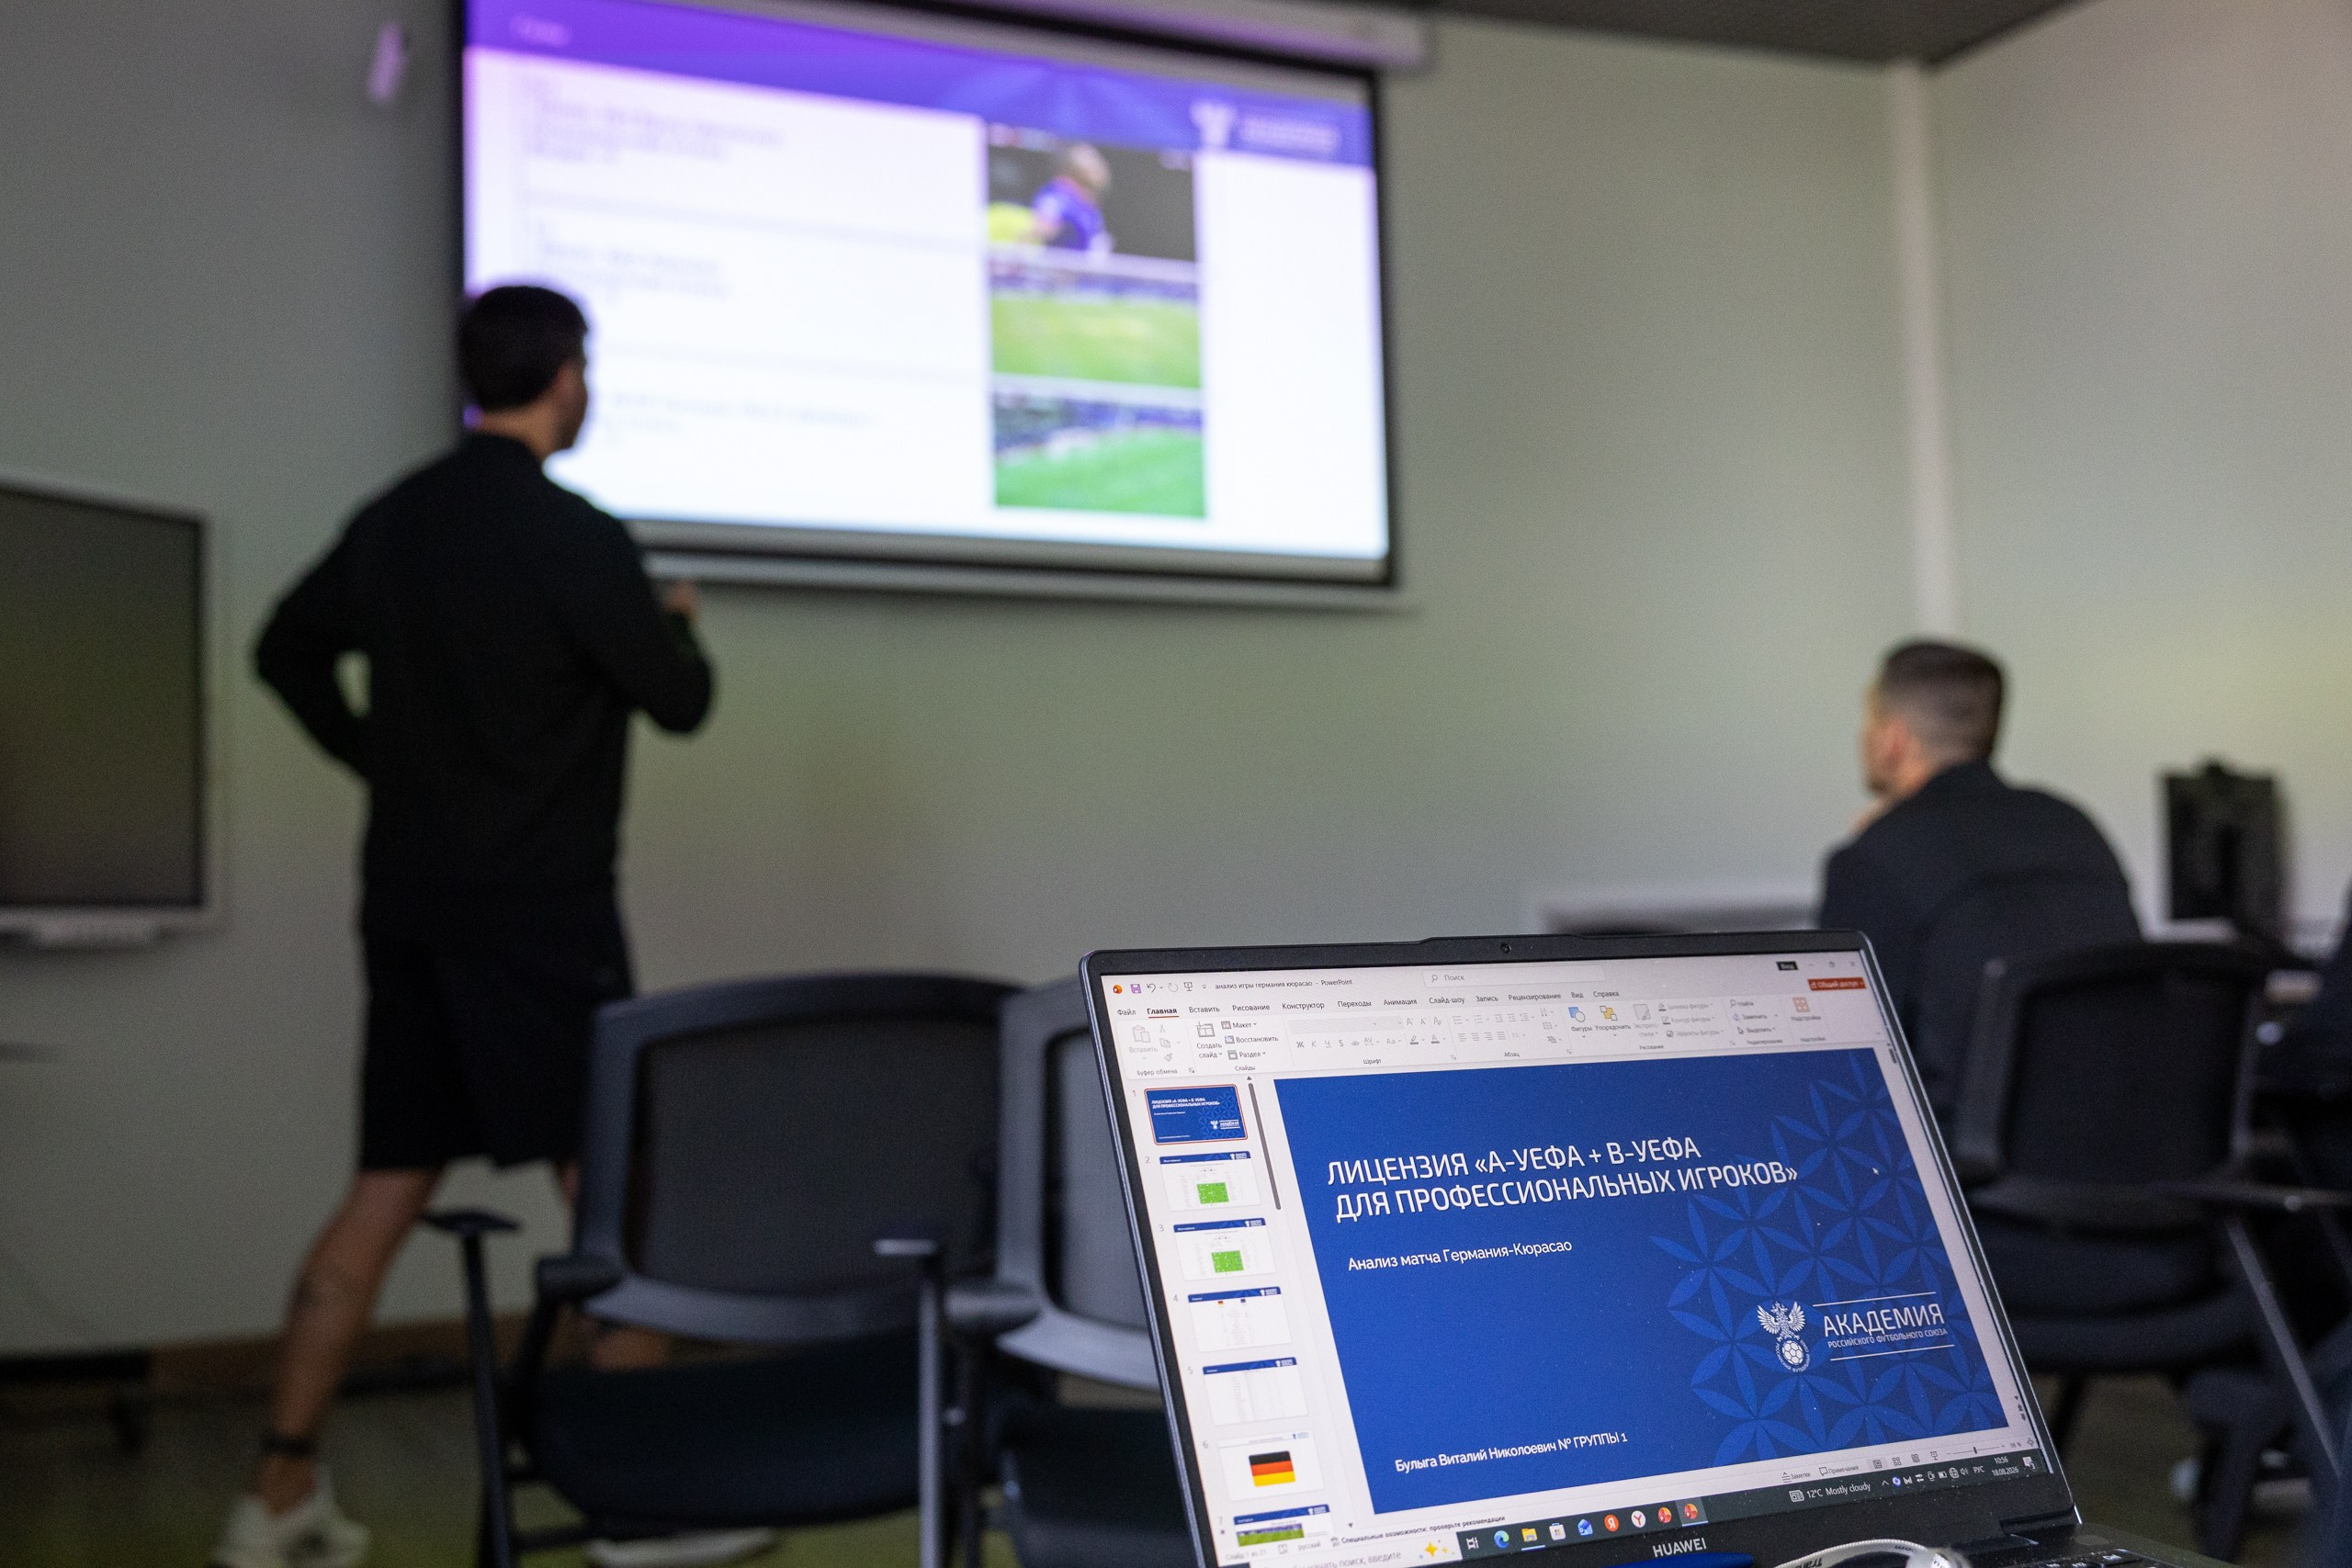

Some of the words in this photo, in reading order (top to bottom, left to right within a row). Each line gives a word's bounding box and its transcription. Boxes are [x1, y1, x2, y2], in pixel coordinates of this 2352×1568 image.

[1238, 983, 1255, 991] игры
[1255, 982, 1285, 990] германия
[1116, 1009, 1136, 1017] Файл
[1147, 1008, 1178, 1016] Главная
[1189, 1006, 1221, 1014] Вставить
[1232, 1004, 1271, 1012] Рисование
[1282, 1002, 1325, 1010] Конструктор
[1337, 1000, 1372, 1009] Переходы
[1384, 998, 1418, 1007] Анимация
[1429, 996, 1465, 1005] Слайд-шоу
[1508, 993, 1562, 1001] Рецензирование
[1571, 991, 1584, 999] Вид
[1592, 990, 1620, 998] Справка
[1196, 1042, 1223, 1050] Создать
[1236, 1035, 1279, 1043] Восстановить
[1238, 1050, 1261, 1058] Раздел
[1136, 1068, 1155, 1077] Буфер
[1234, 1065, 1256, 1073] Слайды
[1328, 1153, 1469, 1186] ЛИЦЕНЗИЯ
[1475, 1145, 1586, 1174] «А-УЕФА
[1589, 1148, 1602, 1163] +
[1606, 1136, 1702, 1165] В-УЕФА
[1336, 1191, 1391, 1224] ДЛЯ
[1395, 1170, 1676, 1213] ПРОФЕССИОНАЛЬНЫХ
[1677, 1161, 1799, 1191] ИГРОКОВ»
[1348, 1258, 1398, 1271] Анализ
[1401, 1252, 1442, 1267] матча
[1442, 1240, 1572, 1264] Германия-Кюрасао
[1824, 1303, 1945, 1337] АКАДЕМИЯ
[1827, 1336, 1875, 1348] РОССИЙСКОГО
[1876, 1330, 1924, 1343] ФУТБОЛЬНОГО
[1925, 1327, 1949, 1338] СОЮЗА
[1395, 1458, 1438, 1474] Булыга
[1440, 1449, 1487, 1465] Виталий
[1488, 1442, 1557, 1460] Николоевич
[1573, 1431, 1620, 1450] ГРУППЫ
[1621, 1432, 1628, 1443] 1
[1973, 1465, 1985, 1474] РУС
[1825, 1485, 1849, 1496] Mostly
[1849, 1481, 1871, 1493] cloudy
[1341, 1532, 1385, 1545] Специальные
[1385, 1526, 1428, 1539] возможности:
[1430, 1521, 1462, 1533] проверьте
[1462, 1516, 1506, 1529] рекомендации
[1653, 1538, 1707, 1557] HUAWEI
[1340, 1556, 1366, 1567] поиск,
[1368, 1551, 1402, 1564] введите
